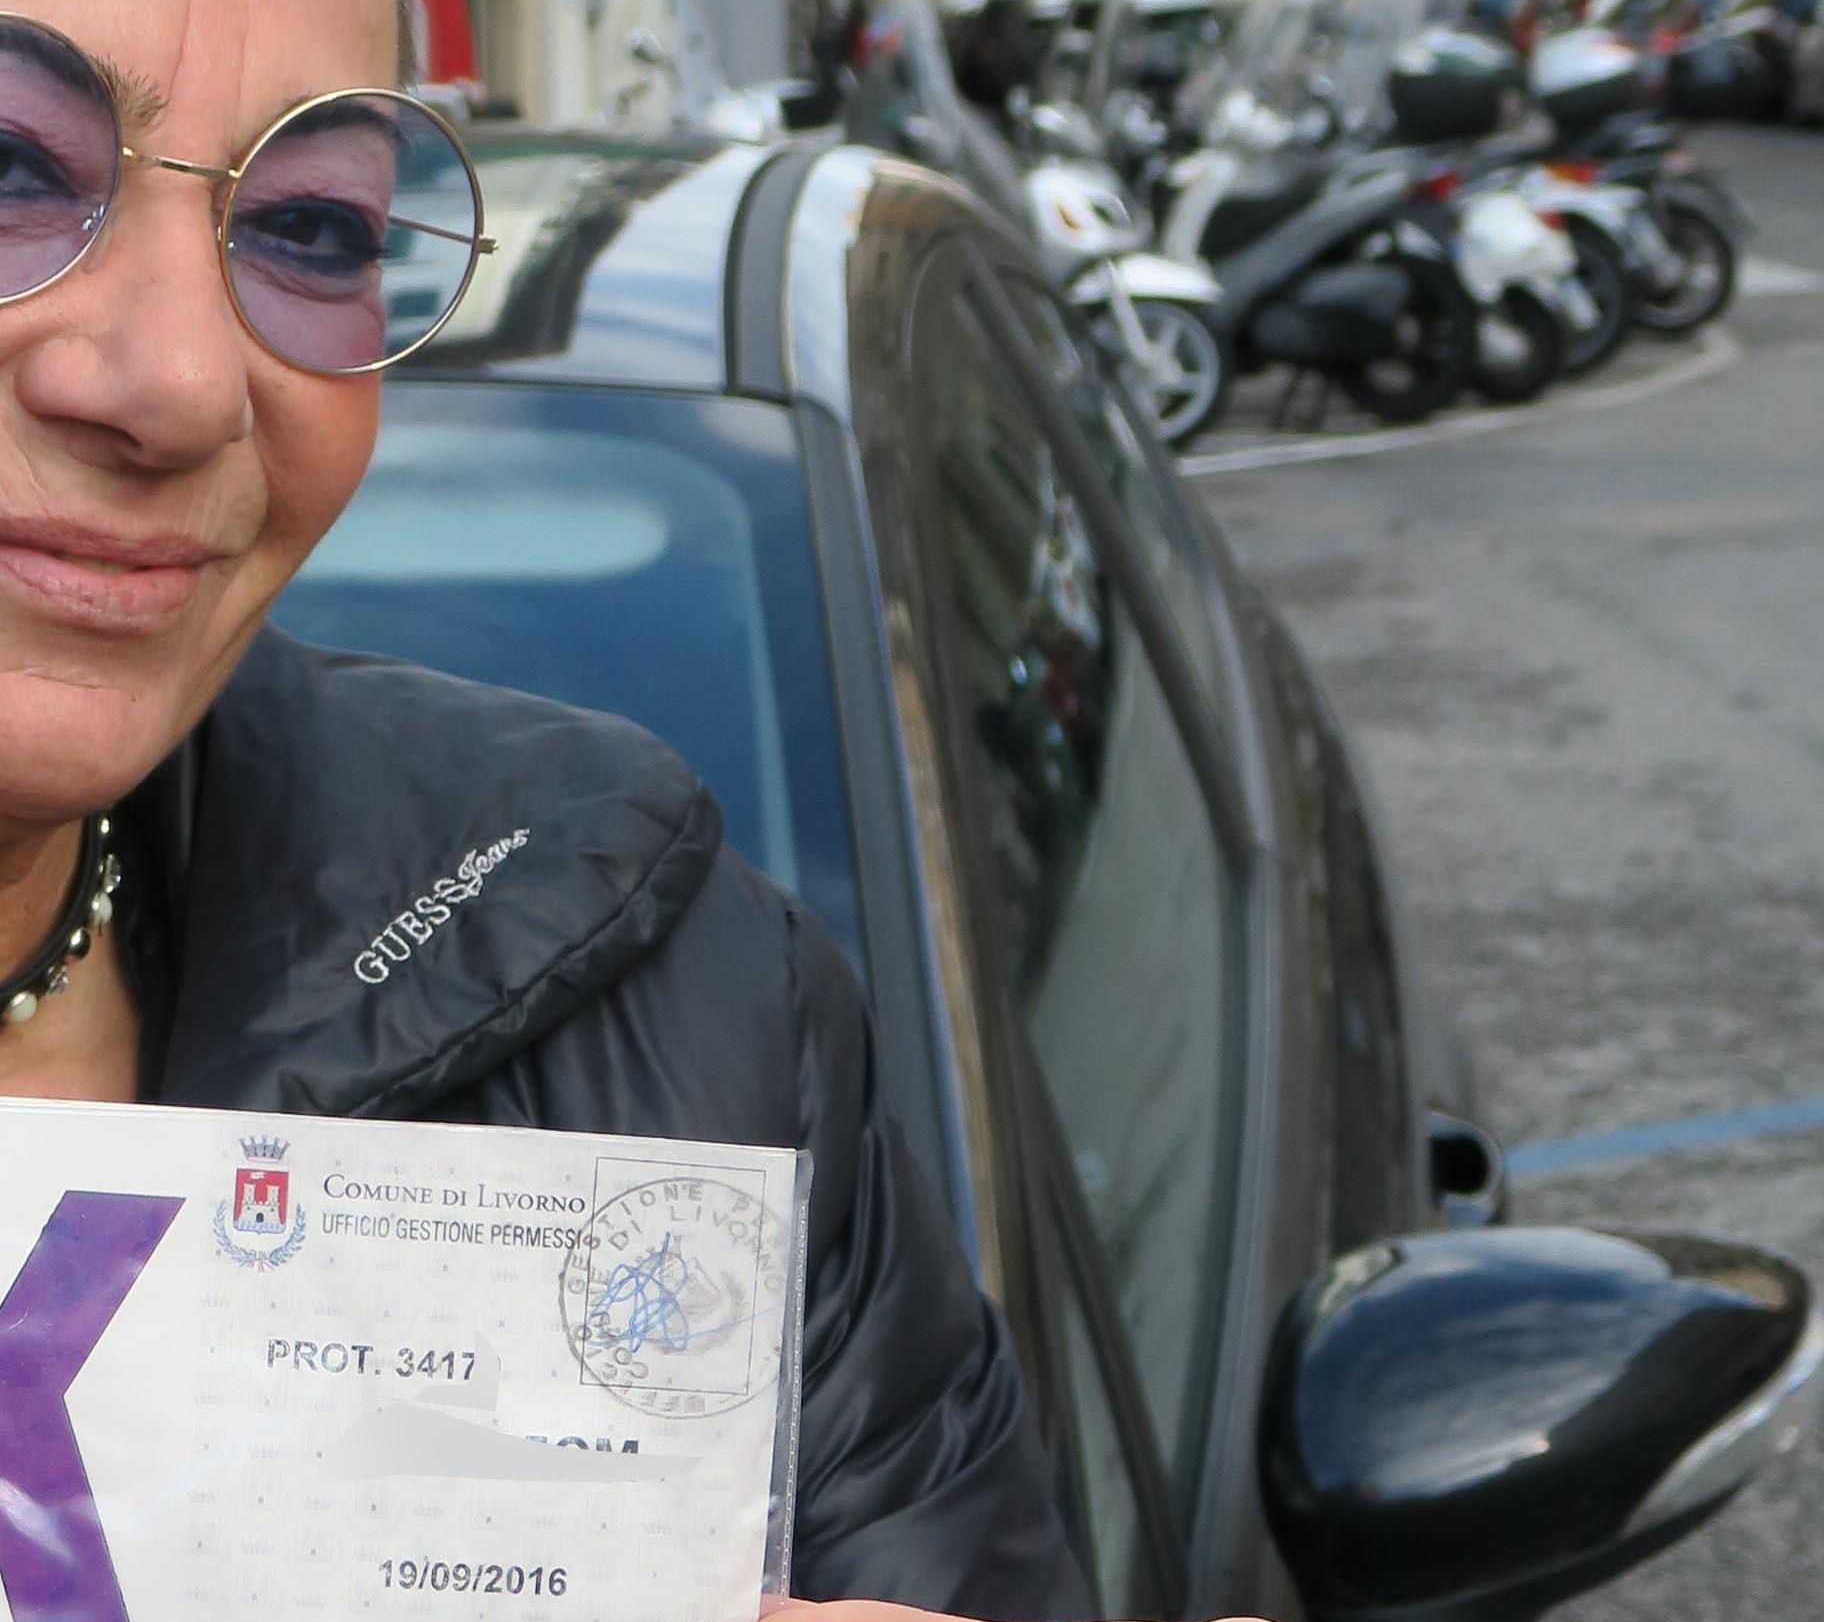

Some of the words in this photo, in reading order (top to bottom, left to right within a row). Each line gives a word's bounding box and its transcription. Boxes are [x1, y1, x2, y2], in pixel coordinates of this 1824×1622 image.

[353, 877, 469, 984] GUESS
[322, 1212, 391, 1238] UFFICIO
[396, 1219, 484, 1245] GESTIONE
[491, 1224, 582, 1250] PERMESSI
[267, 1338, 380, 1375] PROT.
[395, 1347, 475, 1380] 3417
[378, 1557, 567, 1597] 19/09/2016
